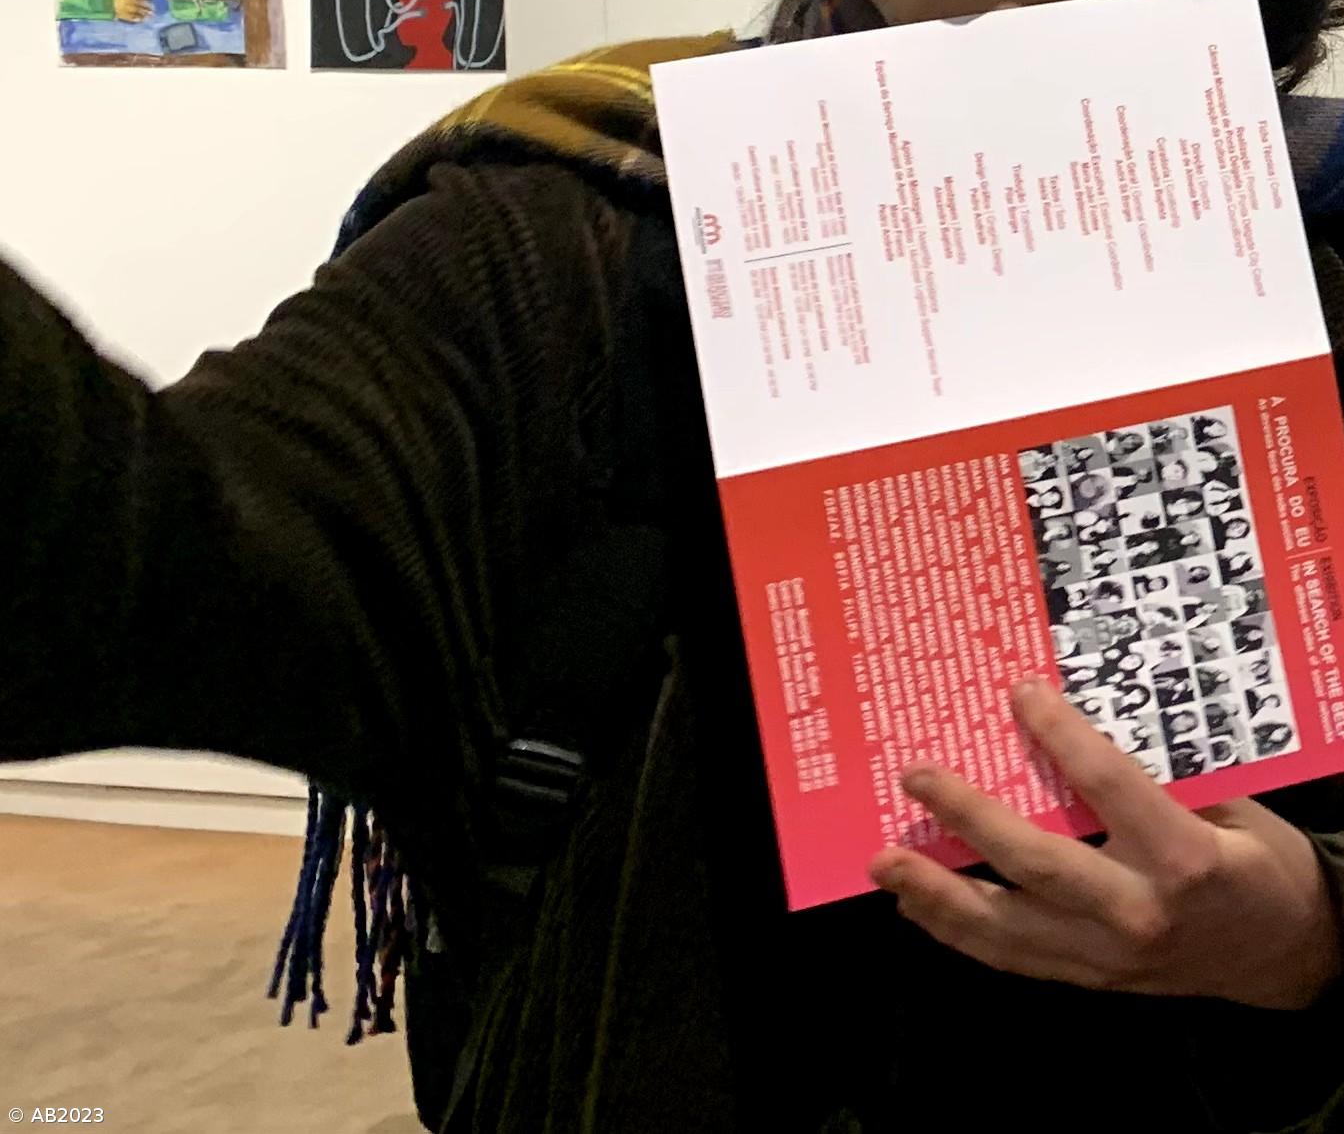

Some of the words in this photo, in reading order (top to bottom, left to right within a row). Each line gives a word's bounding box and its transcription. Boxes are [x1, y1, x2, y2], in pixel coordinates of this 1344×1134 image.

[1256, 119, 1270, 144] Ficha
[1272, 414, 1300, 486] PROCURA
[1288, 493, 1306, 518] DO
[996, 452, 1012, 475] ANA
[1011, 532, 1026, 555] ANA
[1021, 590, 1037, 615] ANA
[1294, 525, 1312, 548] EU
[1301, 558, 1318, 576] IN
[1305, 577, 1331, 642] SEARCH
[1318, 641, 1336, 665] OF
[1323, 668, 1342, 698] THE
